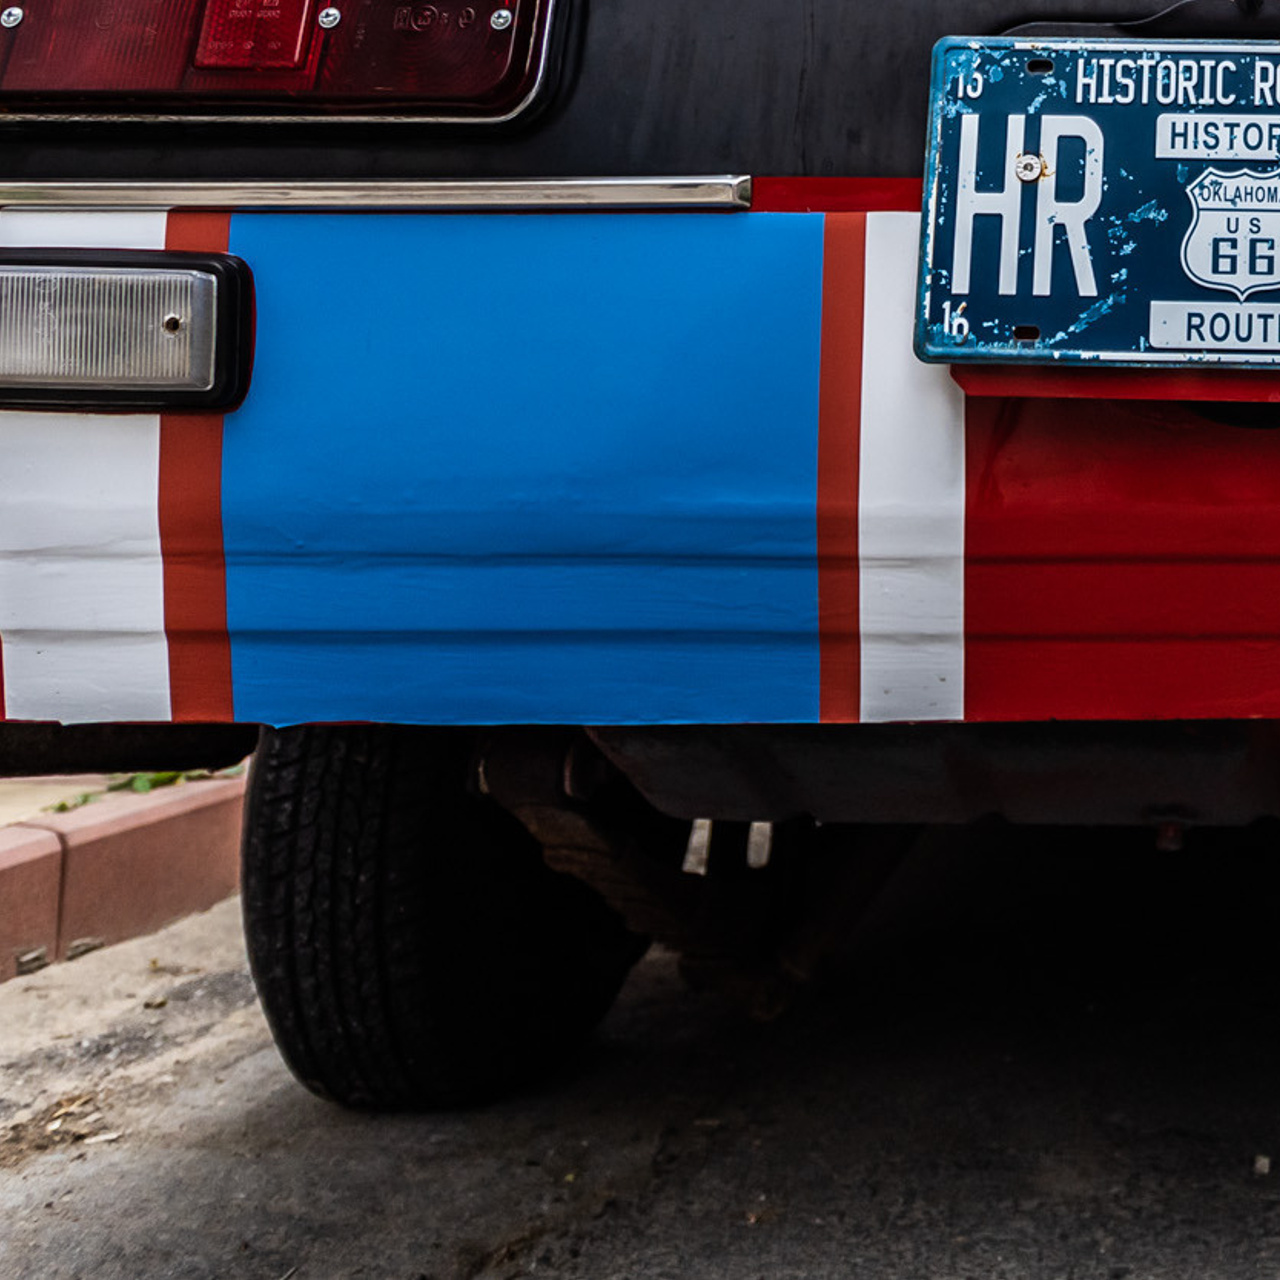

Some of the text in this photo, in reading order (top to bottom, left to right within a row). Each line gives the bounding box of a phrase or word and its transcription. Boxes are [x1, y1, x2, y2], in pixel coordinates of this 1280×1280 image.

[1074, 57, 1237, 108] HISTORIC
[950, 113, 1105, 298] HR
[1210, 237, 1277, 276] 66
